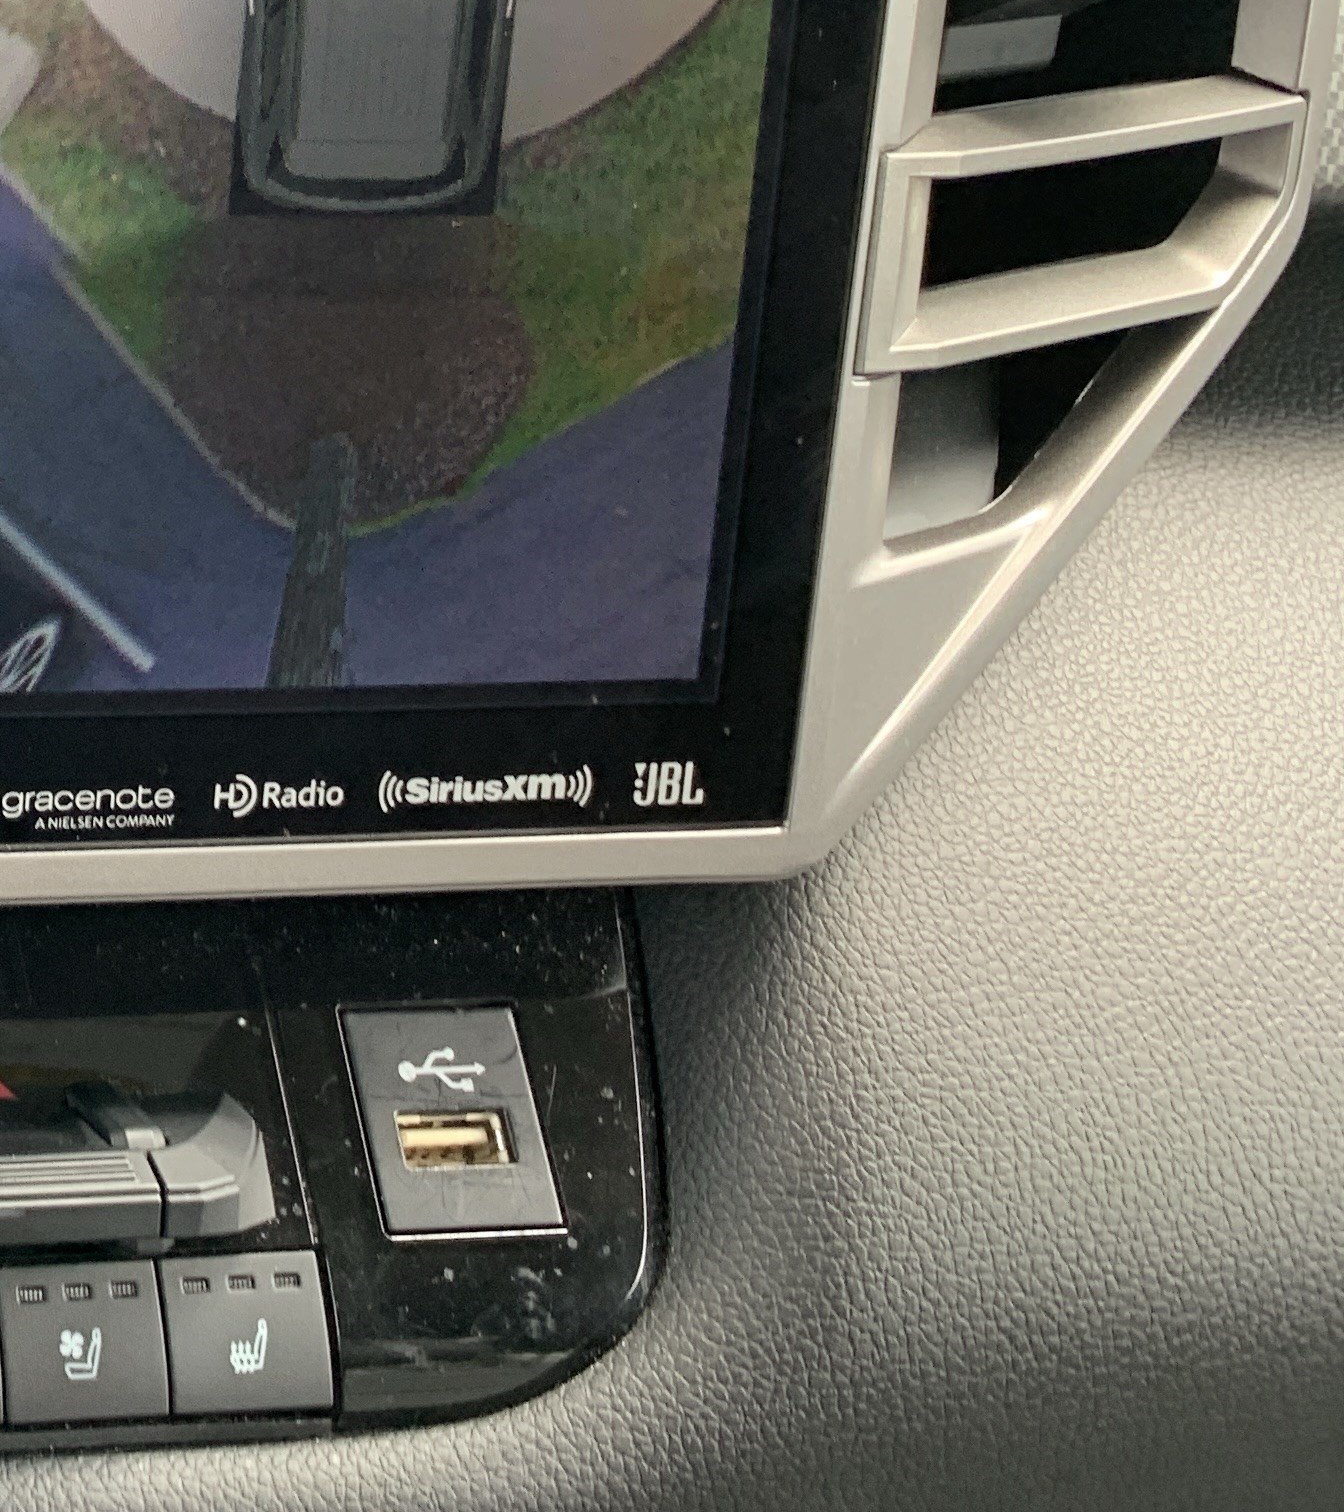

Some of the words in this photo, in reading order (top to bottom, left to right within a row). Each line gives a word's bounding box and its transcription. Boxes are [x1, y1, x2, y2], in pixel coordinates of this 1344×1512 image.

[1, 784, 175, 819] gracenote
[213, 773, 257, 819] HD
[261, 779, 345, 810] Radio
[632, 760, 706, 806] JBL
[34, 816, 46, 830] A
[50, 815, 103, 829] NIELSEN
[106, 812, 175, 828] COMPANY
